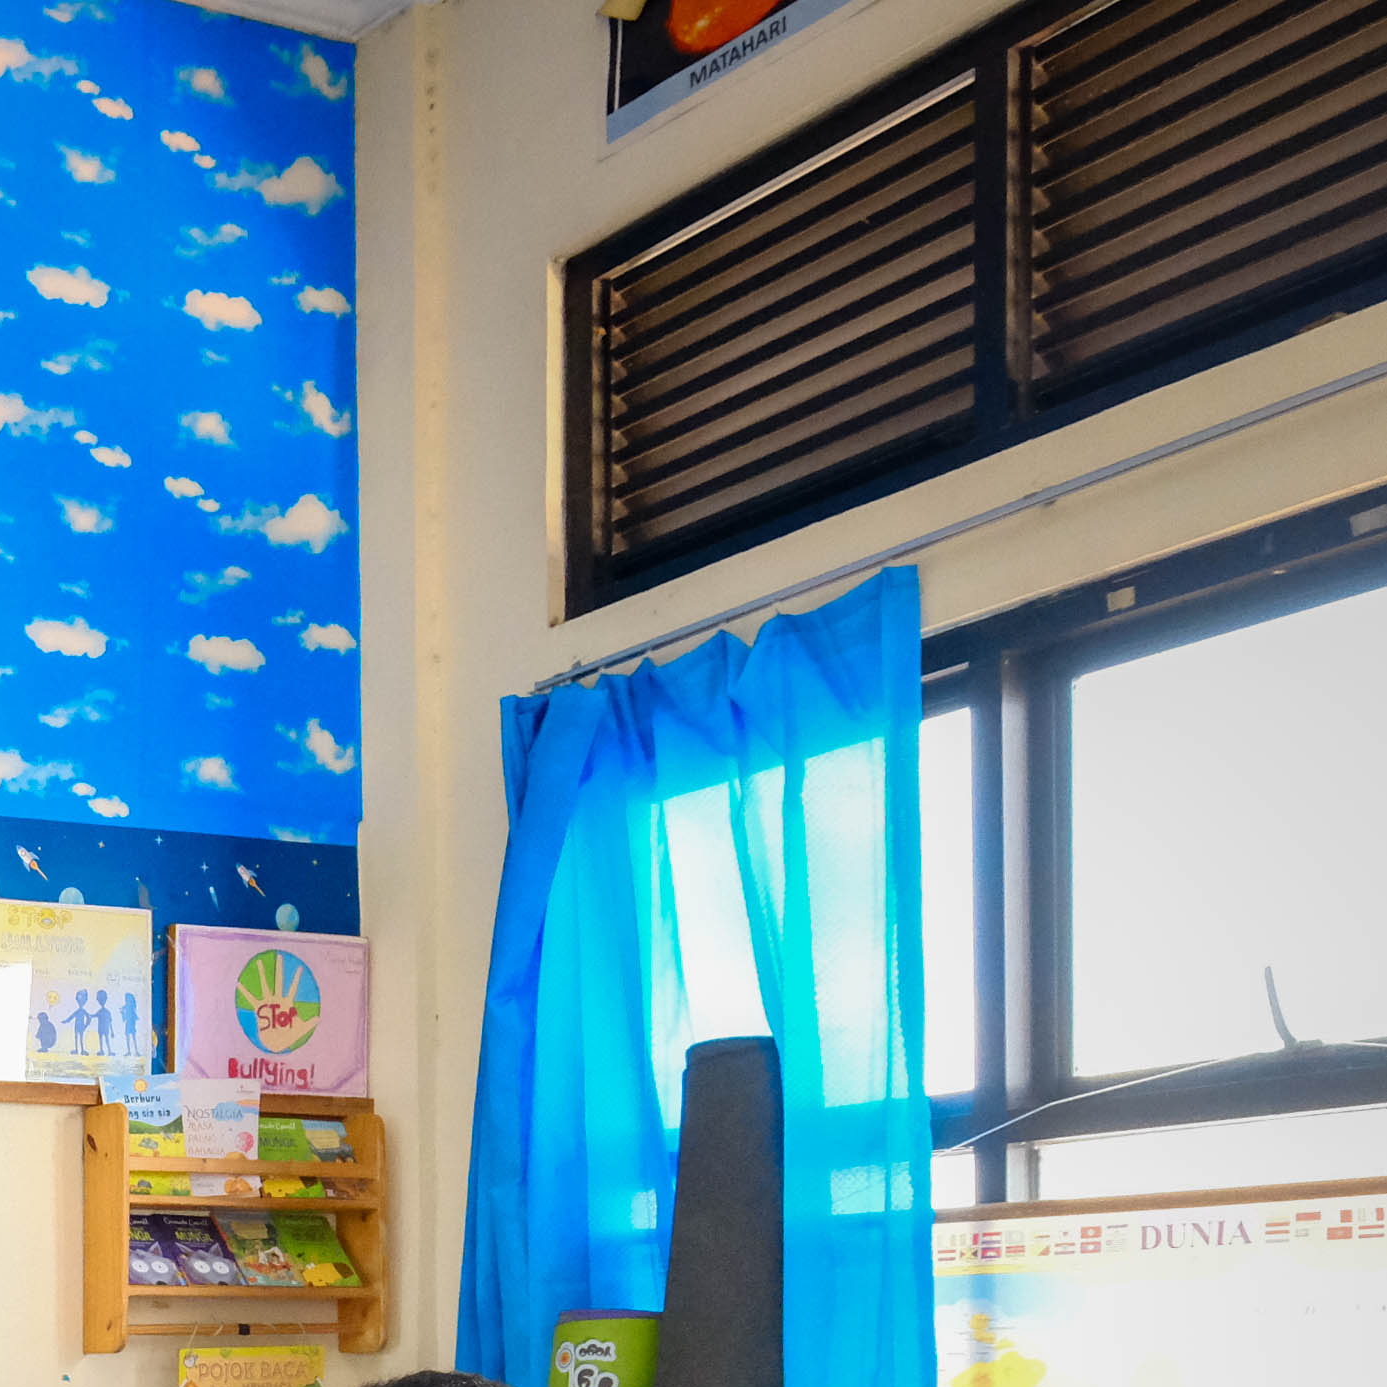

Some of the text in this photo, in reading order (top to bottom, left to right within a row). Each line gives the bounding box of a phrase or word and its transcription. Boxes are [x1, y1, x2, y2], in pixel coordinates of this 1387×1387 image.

[690, 16, 786, 88] MATAHARI
[8, 907, 73, 929] STOP
[124, 1094, 161, 1104] Berburu
[1141, 1220, 1252, 1250] DUNIA
[198, 1361, 307, 1384] POJOK BACA
